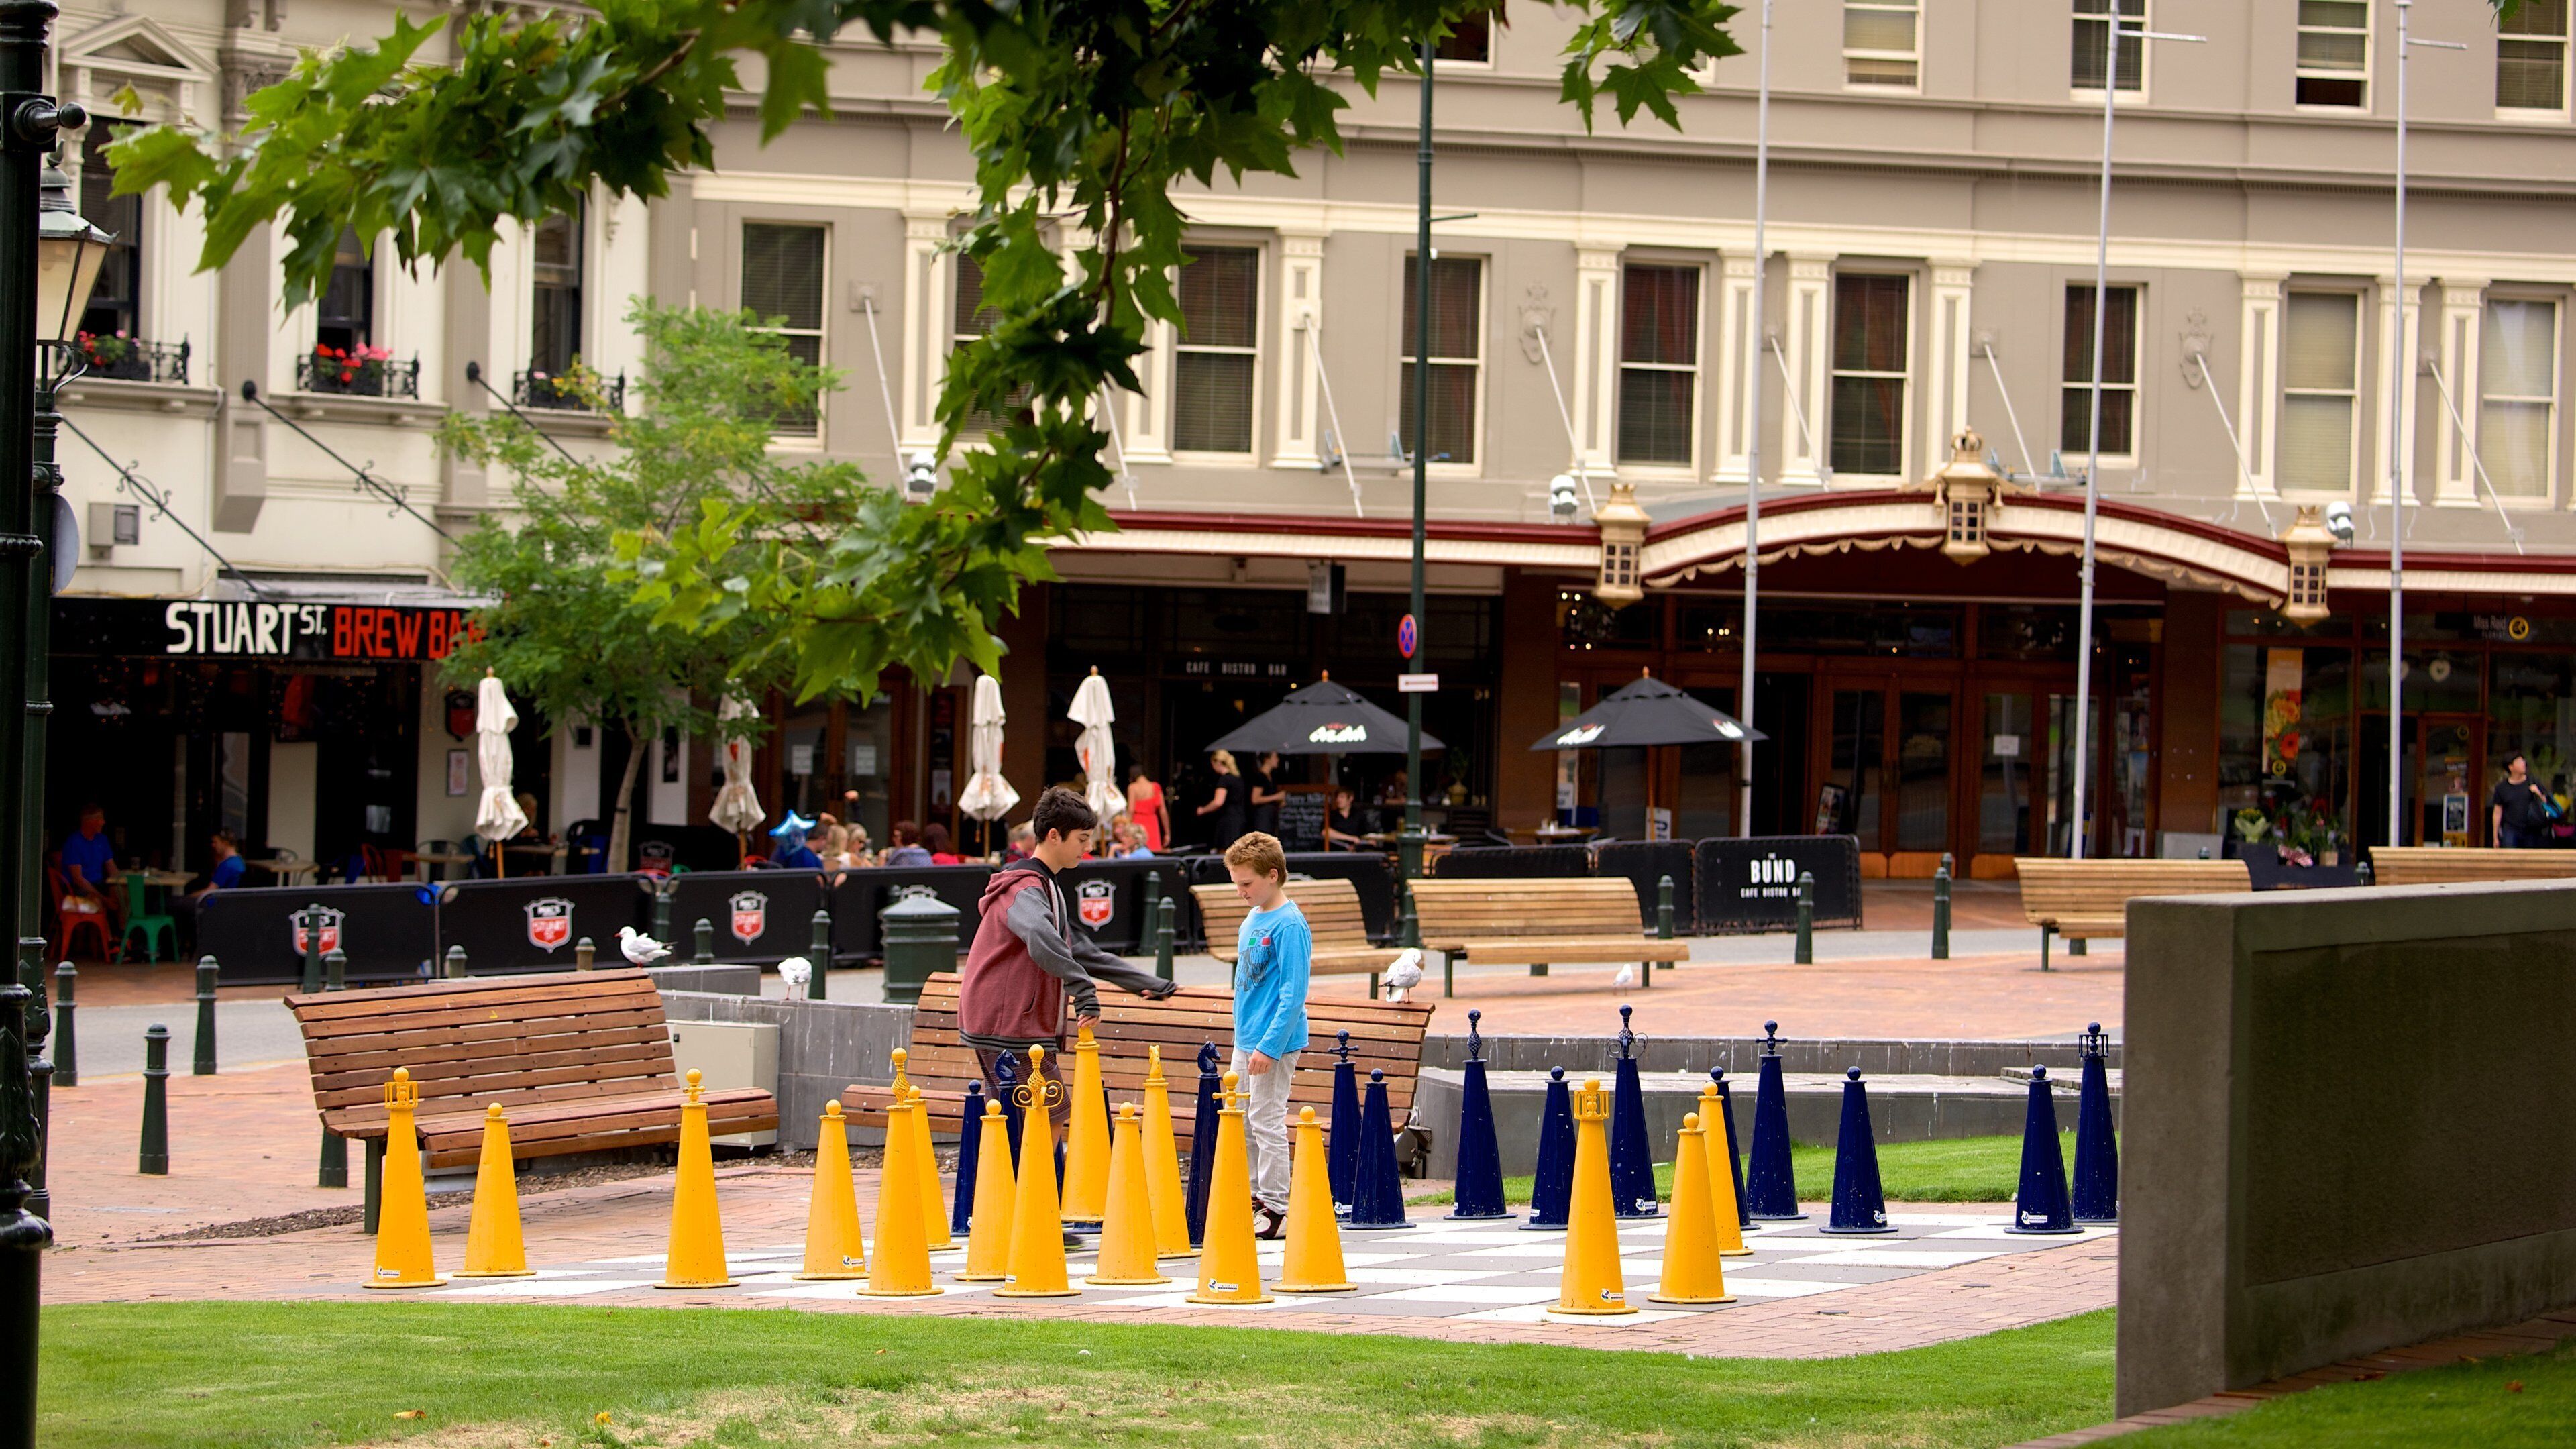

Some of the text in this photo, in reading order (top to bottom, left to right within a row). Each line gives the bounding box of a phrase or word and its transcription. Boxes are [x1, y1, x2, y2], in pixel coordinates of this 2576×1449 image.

[166, 602, 299, 655] STUART
[299, 605, 327, 635] ST.
[333, 607, 423, 658] BREW
[1750, 859, 1796, 884] BUND
